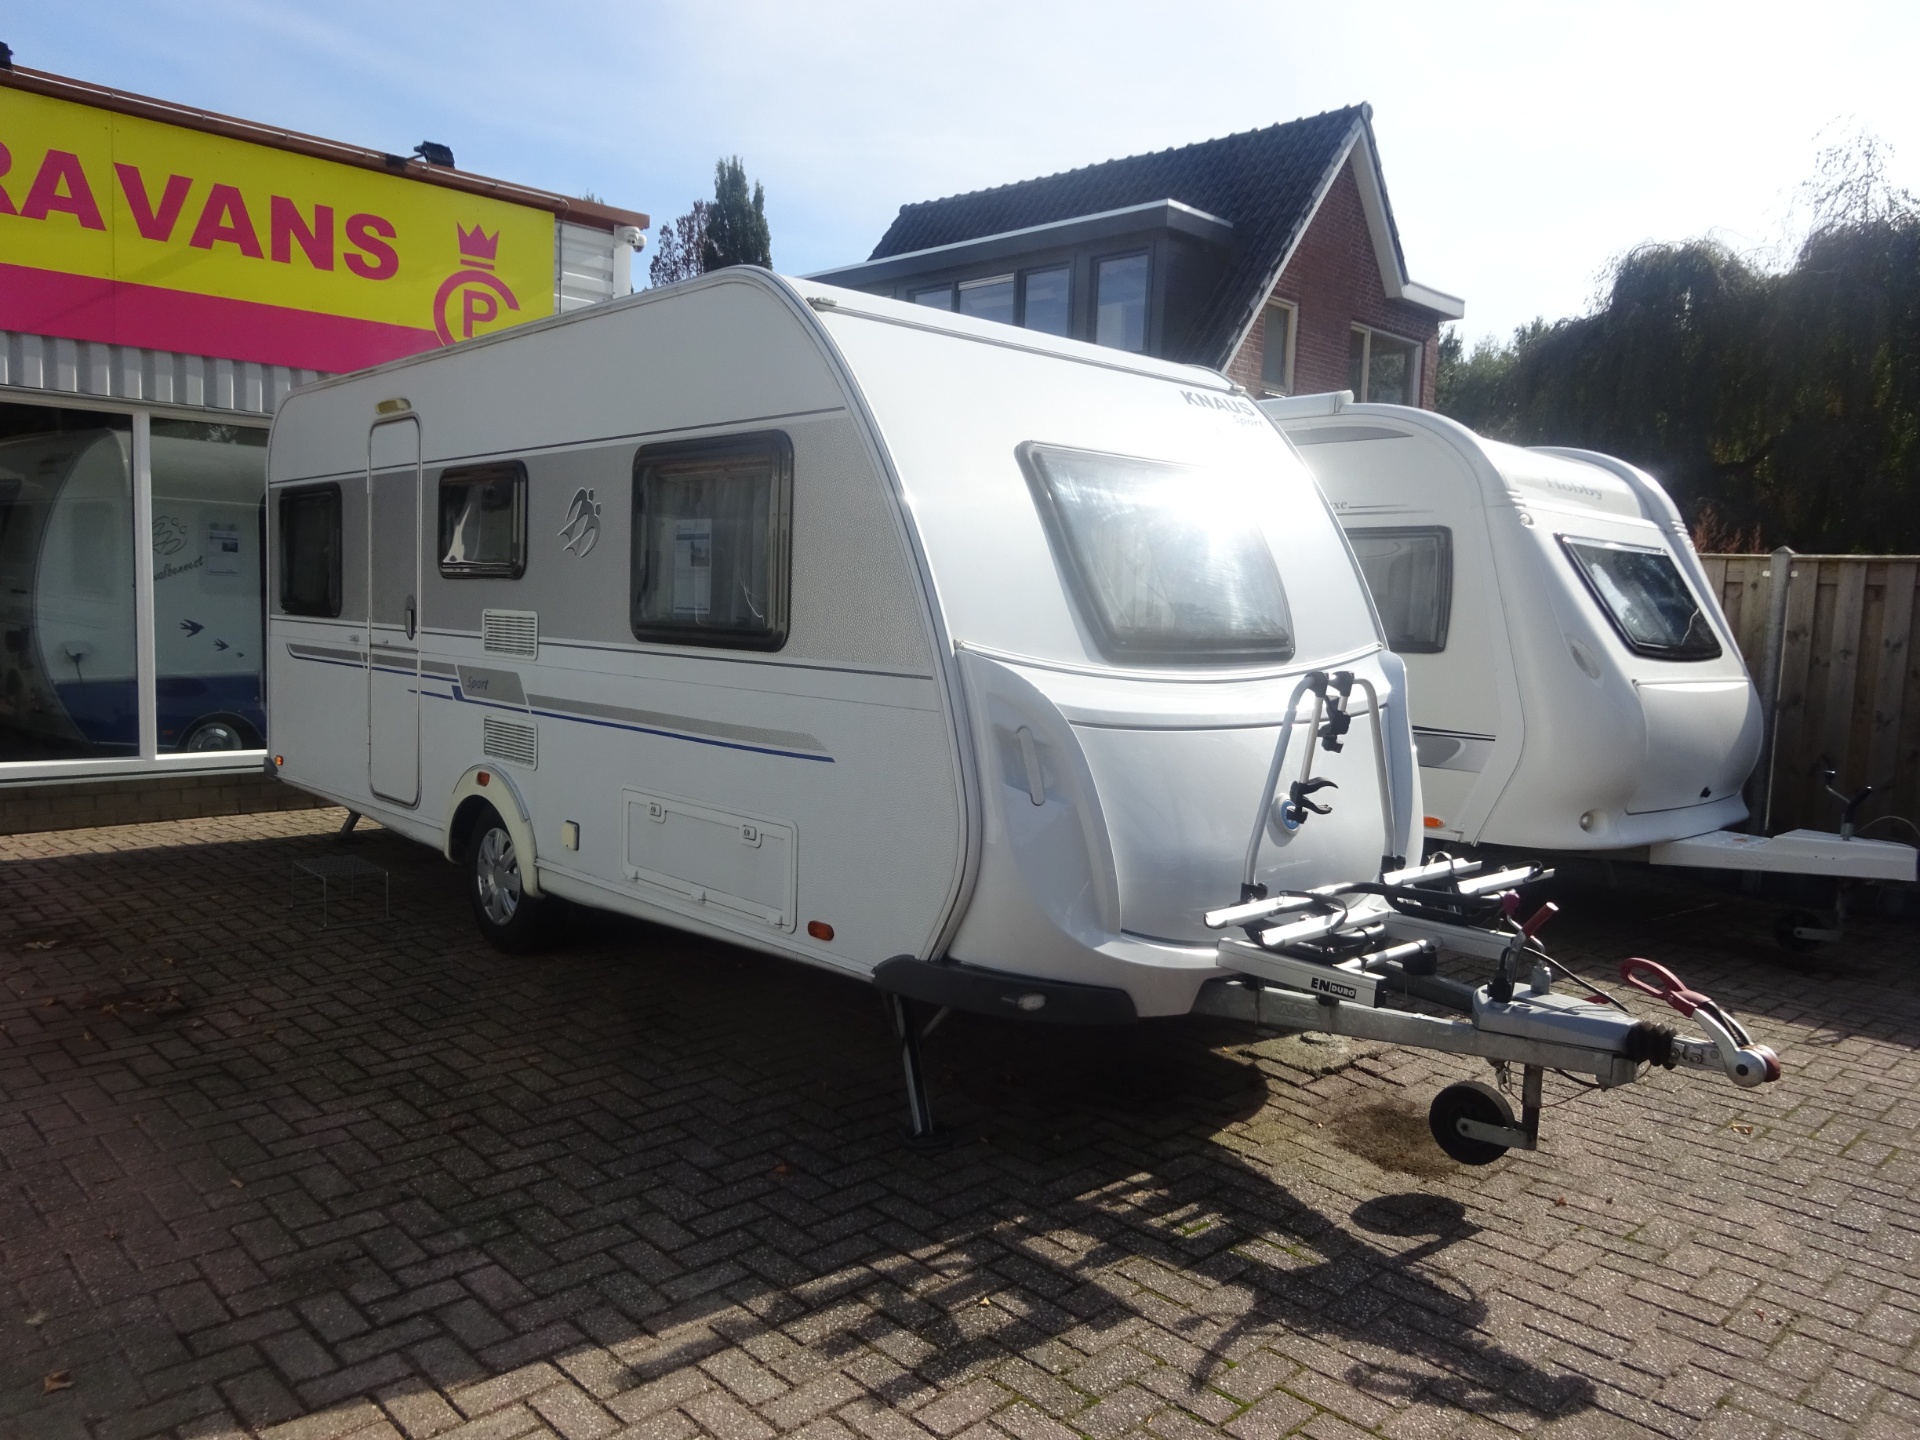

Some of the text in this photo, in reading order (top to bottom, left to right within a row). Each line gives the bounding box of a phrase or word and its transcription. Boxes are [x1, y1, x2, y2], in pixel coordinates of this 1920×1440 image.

[0, 142, 399, 281] AVANS
[1179, 390, 1255, 417] KNAUS
[1232, 415, 1264, 429] Sport
[1544, 476, 1602, 500] Hobby
[467, 676, 489, 691] Sport
[1311, 977, 1356, 999] ENDURO
